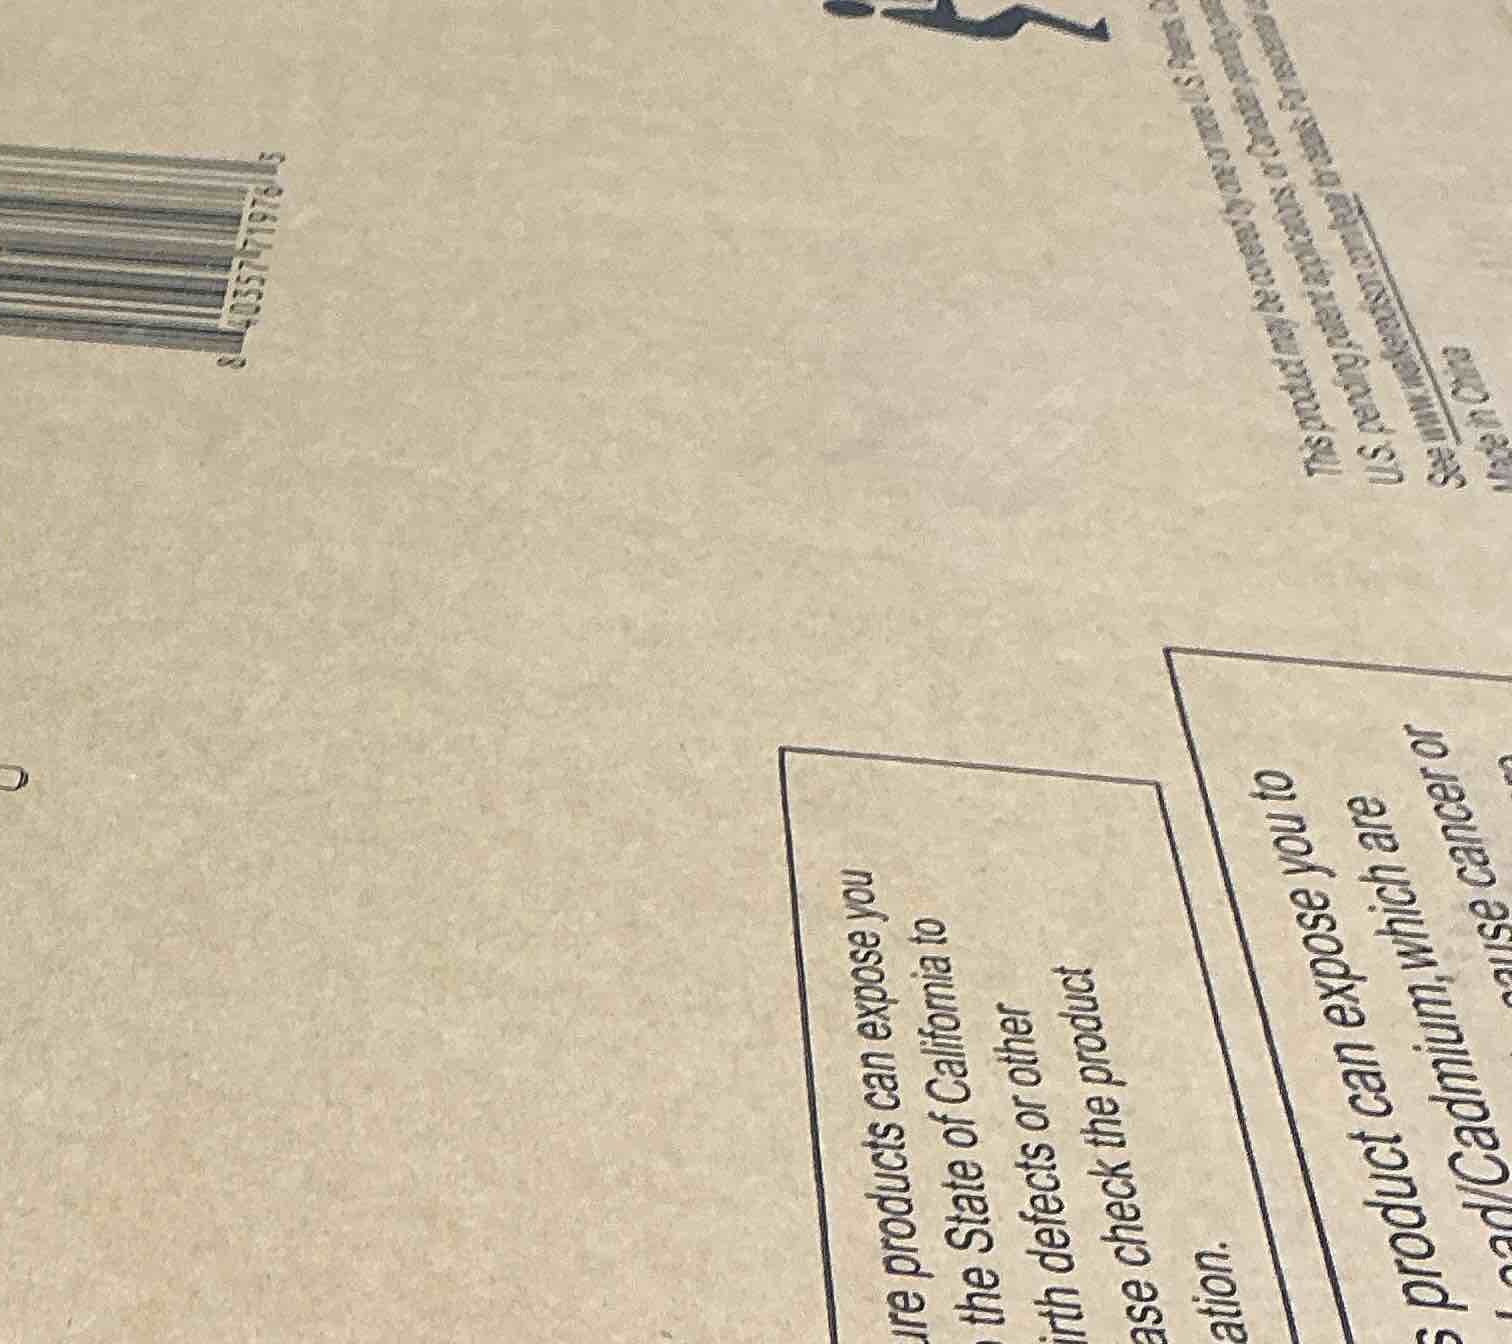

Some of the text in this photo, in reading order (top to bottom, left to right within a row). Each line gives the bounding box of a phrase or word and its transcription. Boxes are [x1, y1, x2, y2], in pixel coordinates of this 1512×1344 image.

[1249, 767, 1295, 801] to
[1348, 796, 1400, 853] are
[1265, 812, 1336, 878] you
[1404, 724, 1512, 1009] use cancer or
[841, 867, 890, 924] you
[909, 917, 947, 946] to
[849, 922, 900, 1041] expose
[1290, 887, 1368, 1028] expose
[914, 953, 973, 1106] California
[991, 1003, 1044, 1090] other
[1054, 965, 1128, 1088] product
[864, 1050, 900, 1111] can
[1016, 1096, 1051, 1130] or
[1332, 1041, 1393, 1117] can
[935, 1111, 980, 1151] of
[1081, 1095, 1128, 1152] the
[864, 1118, 936, 1281] products
[944, 1159, 994, 1255] State
[1012, 1142, 1076, 1275] defects
[1090, 1157, 1158, 1268] check
[1349, 1132, 1470, 1313] product
[954, 1265, 1005, 1328] the
